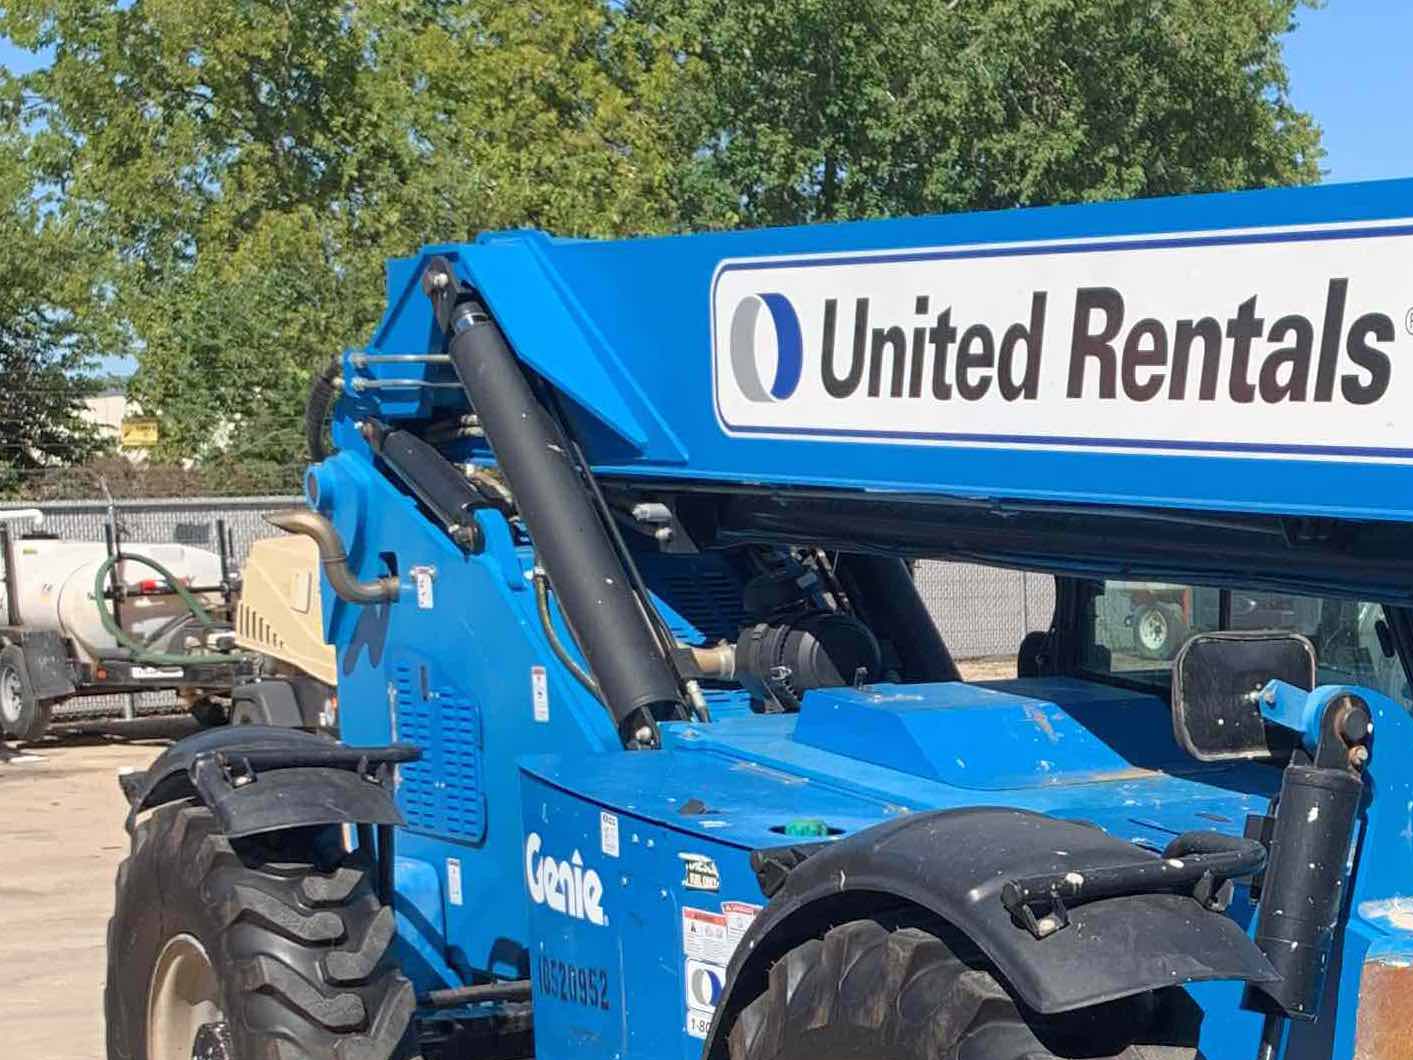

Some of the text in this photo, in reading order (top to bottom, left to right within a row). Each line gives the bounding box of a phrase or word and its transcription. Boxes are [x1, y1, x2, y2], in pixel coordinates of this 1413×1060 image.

[820, 291, 1048, 401] United
[1065, 277, 1396, 405] Rentals
[526, 832, 604, 926] Genie
